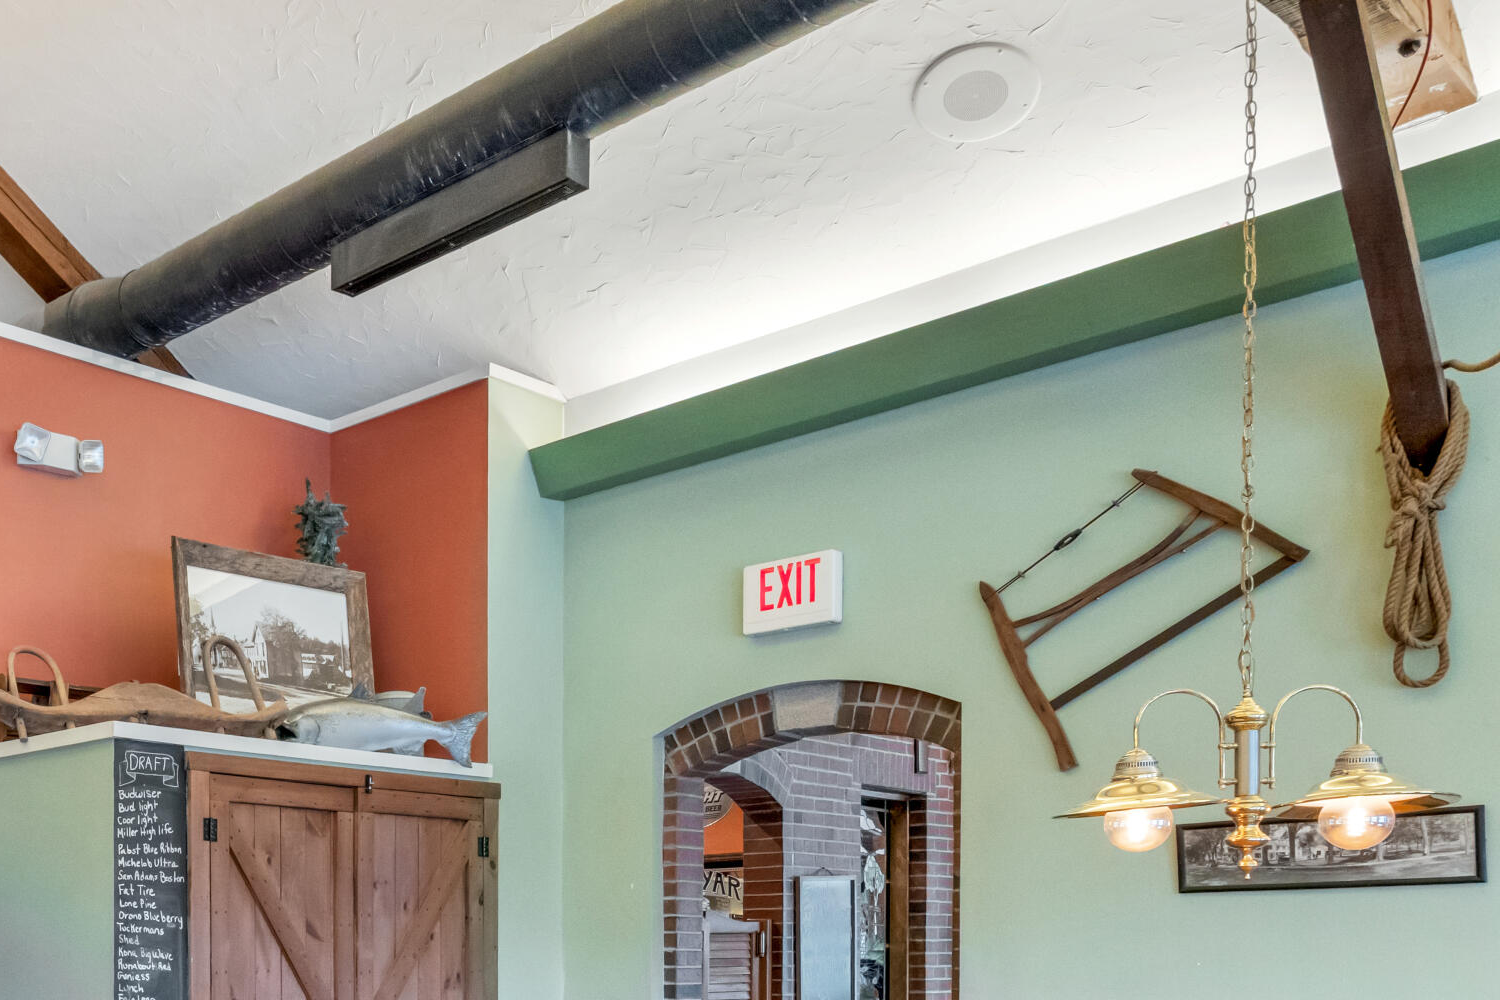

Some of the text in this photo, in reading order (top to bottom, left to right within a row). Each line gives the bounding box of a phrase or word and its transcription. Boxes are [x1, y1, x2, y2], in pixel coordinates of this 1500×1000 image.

[760, 557, 821, 612] EXIT
[130, 754, 170, 771] DRAFT
[118, 800, 158, 816] Bud light
[138, 812, 158, 828] light
[117, 828, 138, 838] Miller
[140, 828, 156, 840] High
[118, 842, 181, 854] Pabst Blue Ribbon
[118, 856, 178, 868] Michelob Ultra
[118, 870, 133, 880] Sam
[160, 871, 184, 883] Boston
[119, 884, 155, 896] Fat Tire
[120, 898, 157, 909] Lone Pine
[119, 911, 183, 929] Orono Blueberry
[119, 934, 140, 945] Shed
[118, 947, 137, 957] Kona
[158, 961, 171, 971] Red
